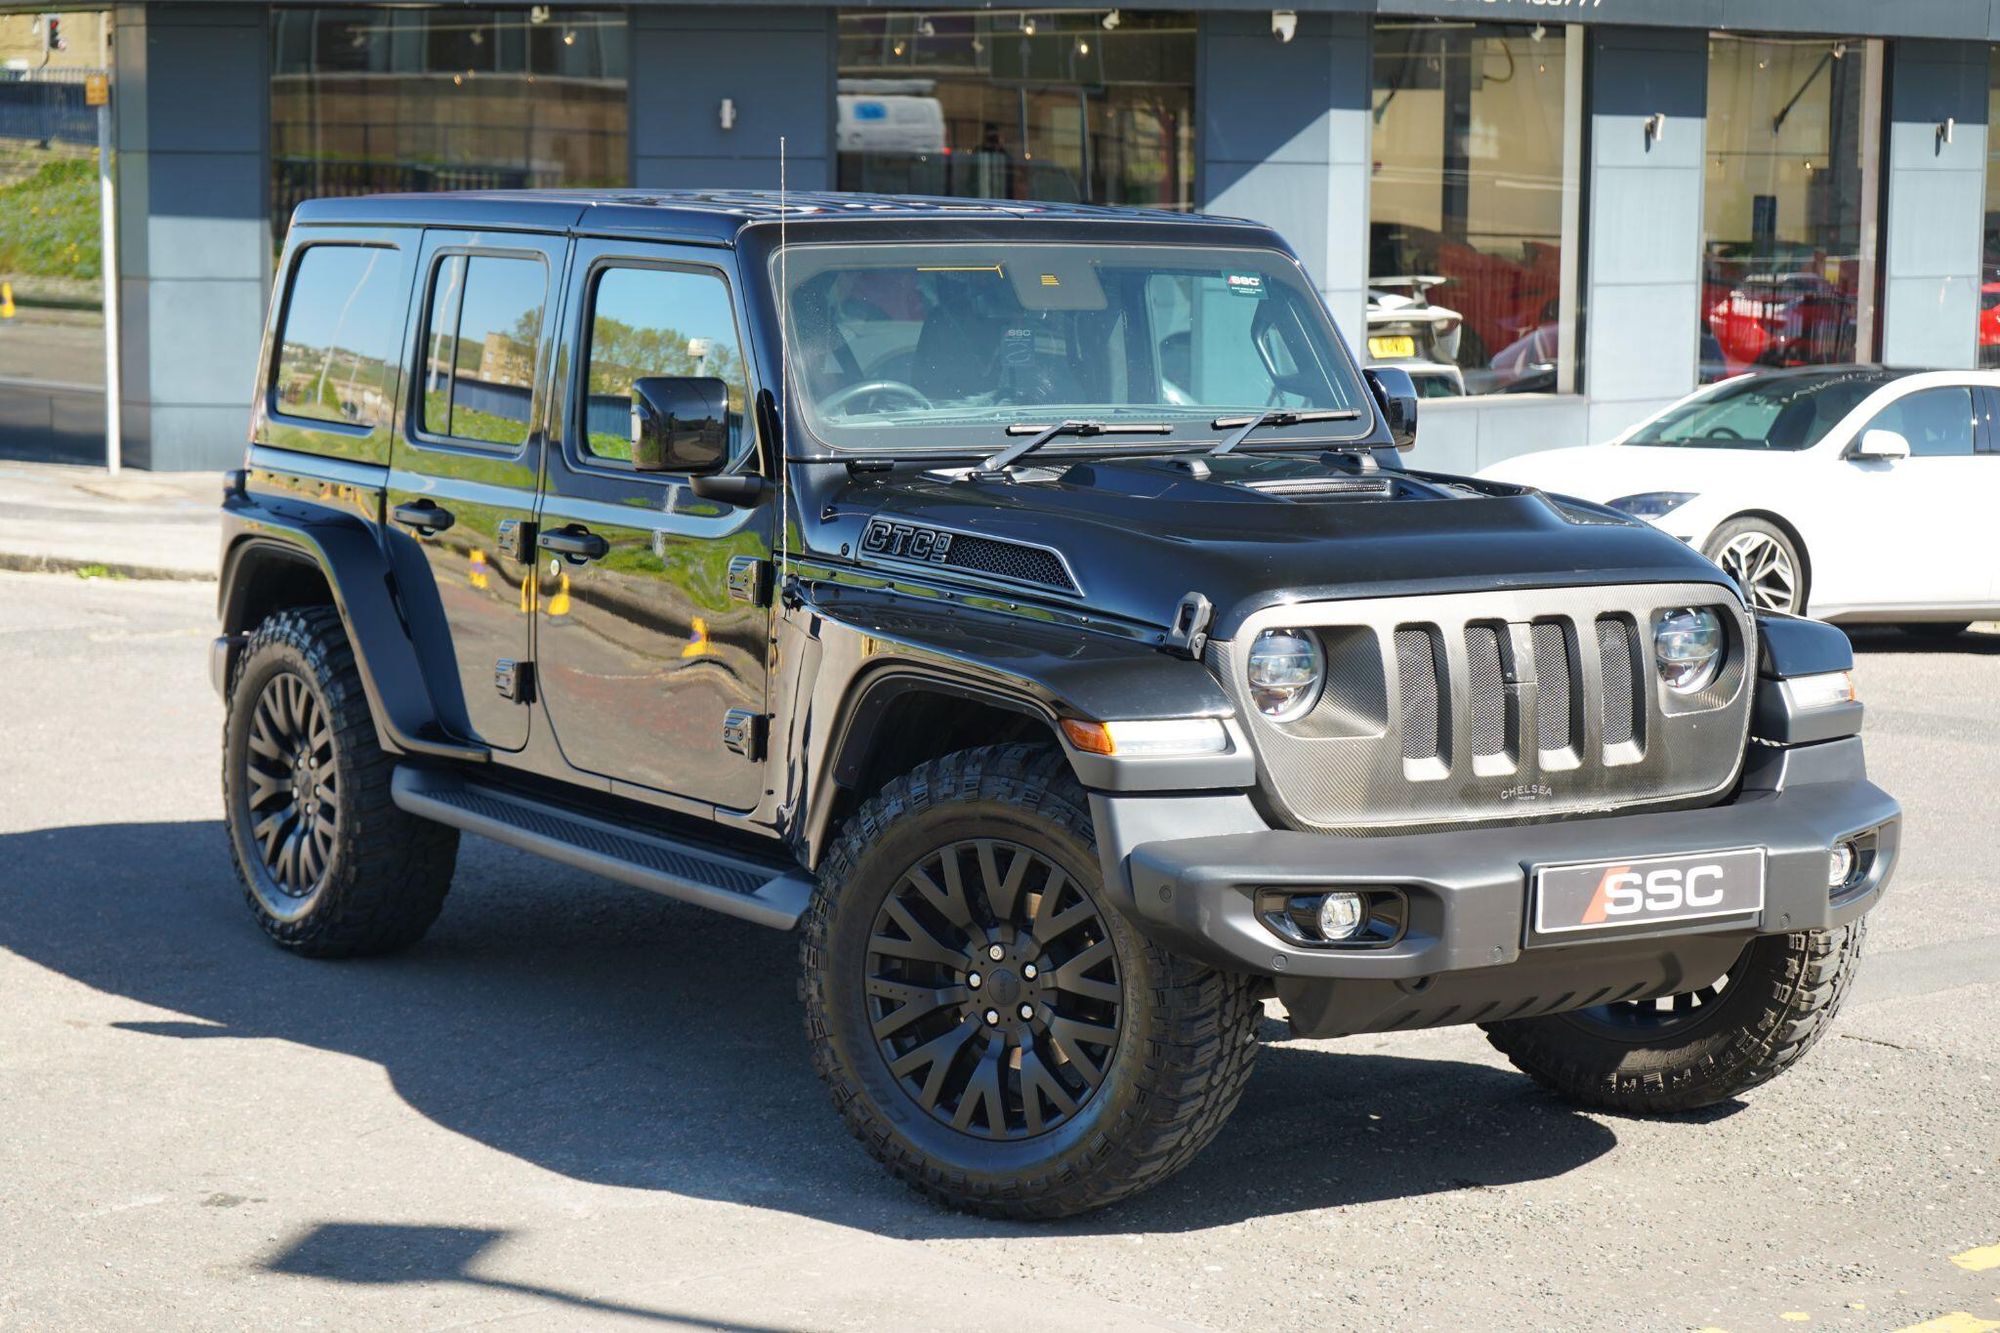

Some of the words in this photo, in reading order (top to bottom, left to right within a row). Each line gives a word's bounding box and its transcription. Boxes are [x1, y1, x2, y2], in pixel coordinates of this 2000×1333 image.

[1230, 275, 1260, 286] SSC
[1500, 784, 1552, 800] CHELSEA
[1603, 864, 1724, 915] SSC
